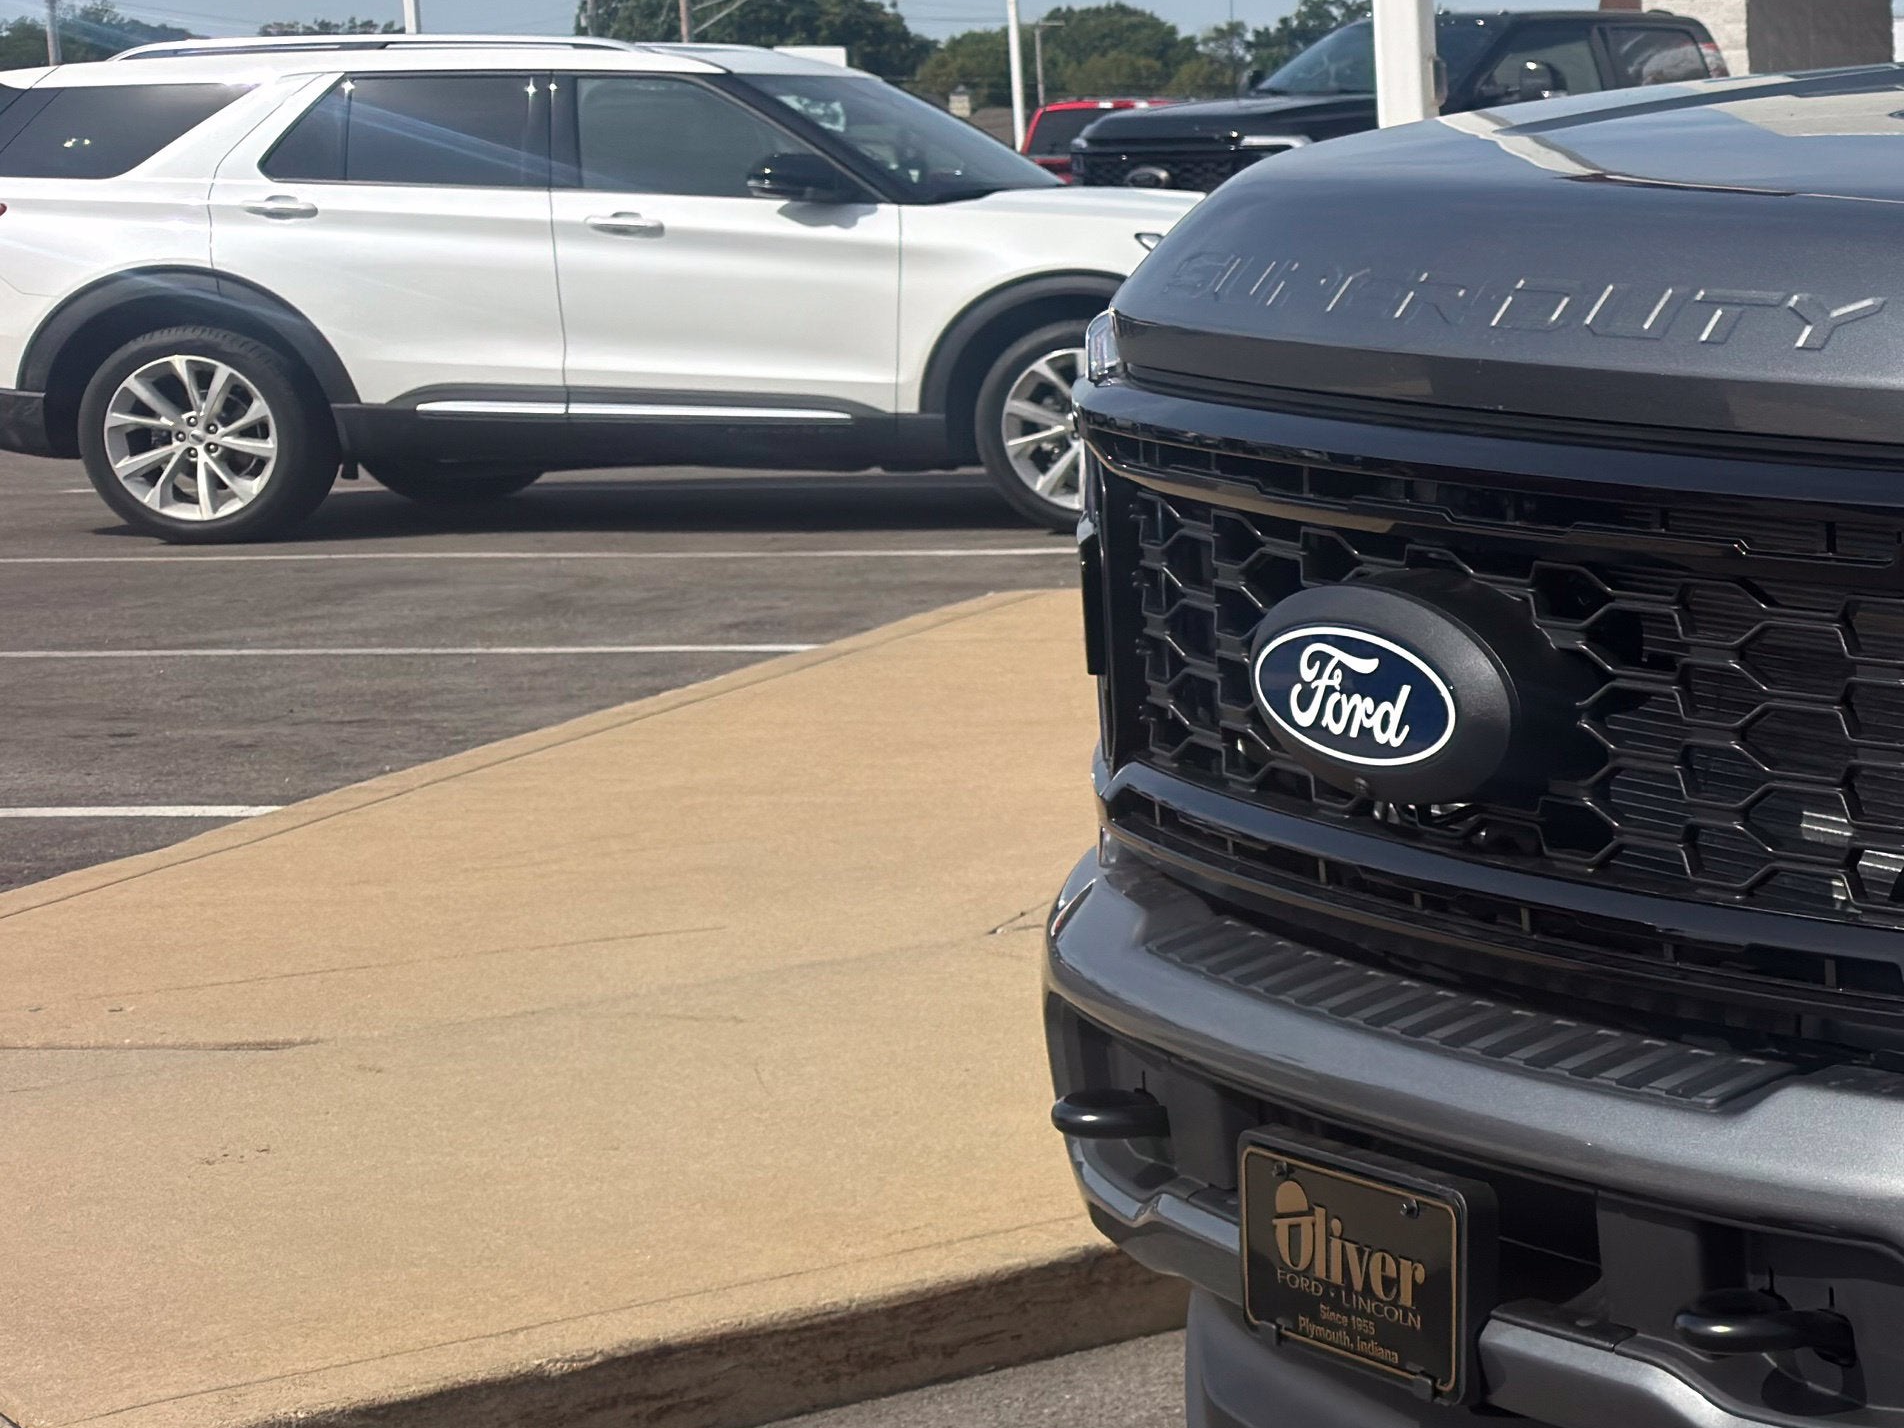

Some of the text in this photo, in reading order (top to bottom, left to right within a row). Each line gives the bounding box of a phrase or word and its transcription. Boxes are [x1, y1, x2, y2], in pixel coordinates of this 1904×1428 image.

[1489, 278, 1887, 351] DUTY
[1289, 642, 1410, 747] Ford
[1272, 1180, 1425, 1309] Oliver
[1277, 1268, 1421, 1331] FORD LINCOLN
[1319, 1302, 1376, 1335] Since 1955
[1298, 1313, 1399, 1364] Plymouth, Indiana
